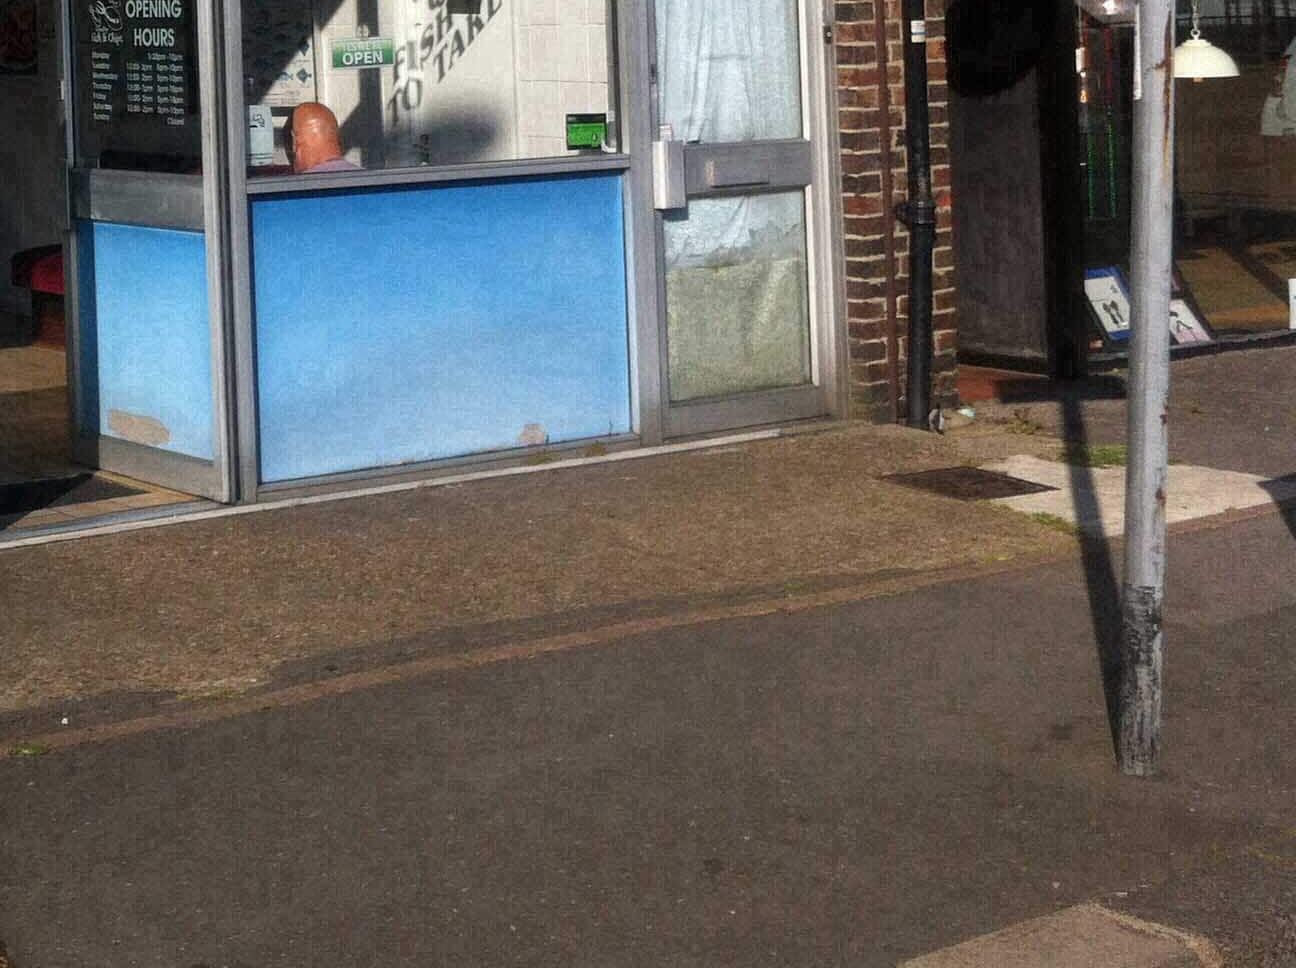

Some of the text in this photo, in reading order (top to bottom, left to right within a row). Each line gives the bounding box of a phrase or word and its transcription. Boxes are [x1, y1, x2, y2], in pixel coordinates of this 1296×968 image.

[125, 0, 182, 18] OPENING
[134, 28, 175, 47] HOURS
[342, 50, 384, 66] OPEN
